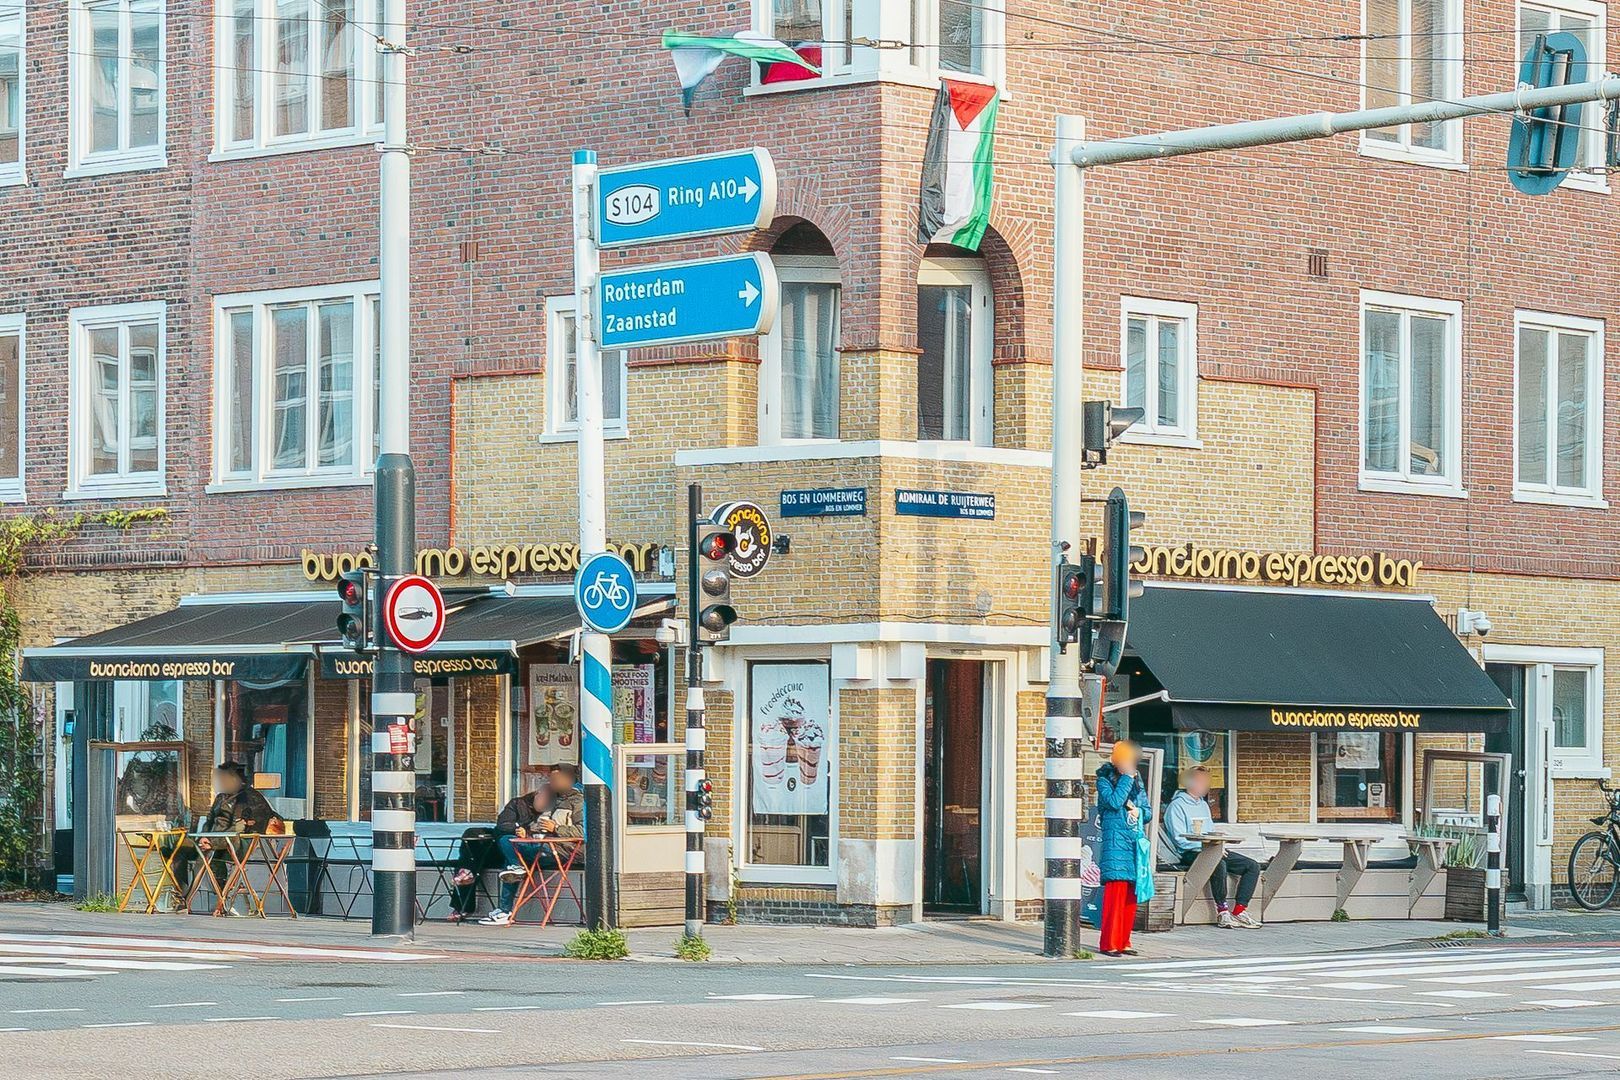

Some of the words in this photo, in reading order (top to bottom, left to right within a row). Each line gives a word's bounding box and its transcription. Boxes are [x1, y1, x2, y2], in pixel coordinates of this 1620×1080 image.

[668, 186, 704, 208] Ring
[709, 178, 737, 201] A10
[612, 193, 653, 217] S104
[604, 278, 685, 303] Rotterdam
[606, 307, 677, 333] Zaanstad
[782, 494, 797, 505] BOS
[799, 493, 810, 504] EN
[813, 491, 863, 503] LOMMERWEG
[898, 492, 937, 504] ADMIRAAL
[938, 494, 948, 505] DE
[951, 495, 994, 509] RUIJTERWEG
[751, 548, 766, 567] bar
[1266, 550, 1375, 587] espresso
[1379, 551, 1424, 588] bar
[162, 661, 211, 679] espresso
[212, 659, 235, 676] bar
[413, 659, 473, 676] espresso
[472, 656, 498, 670] bar
[1348, 711, 1398, 730] espresso
[1398, 710, 1421, 728] bar
